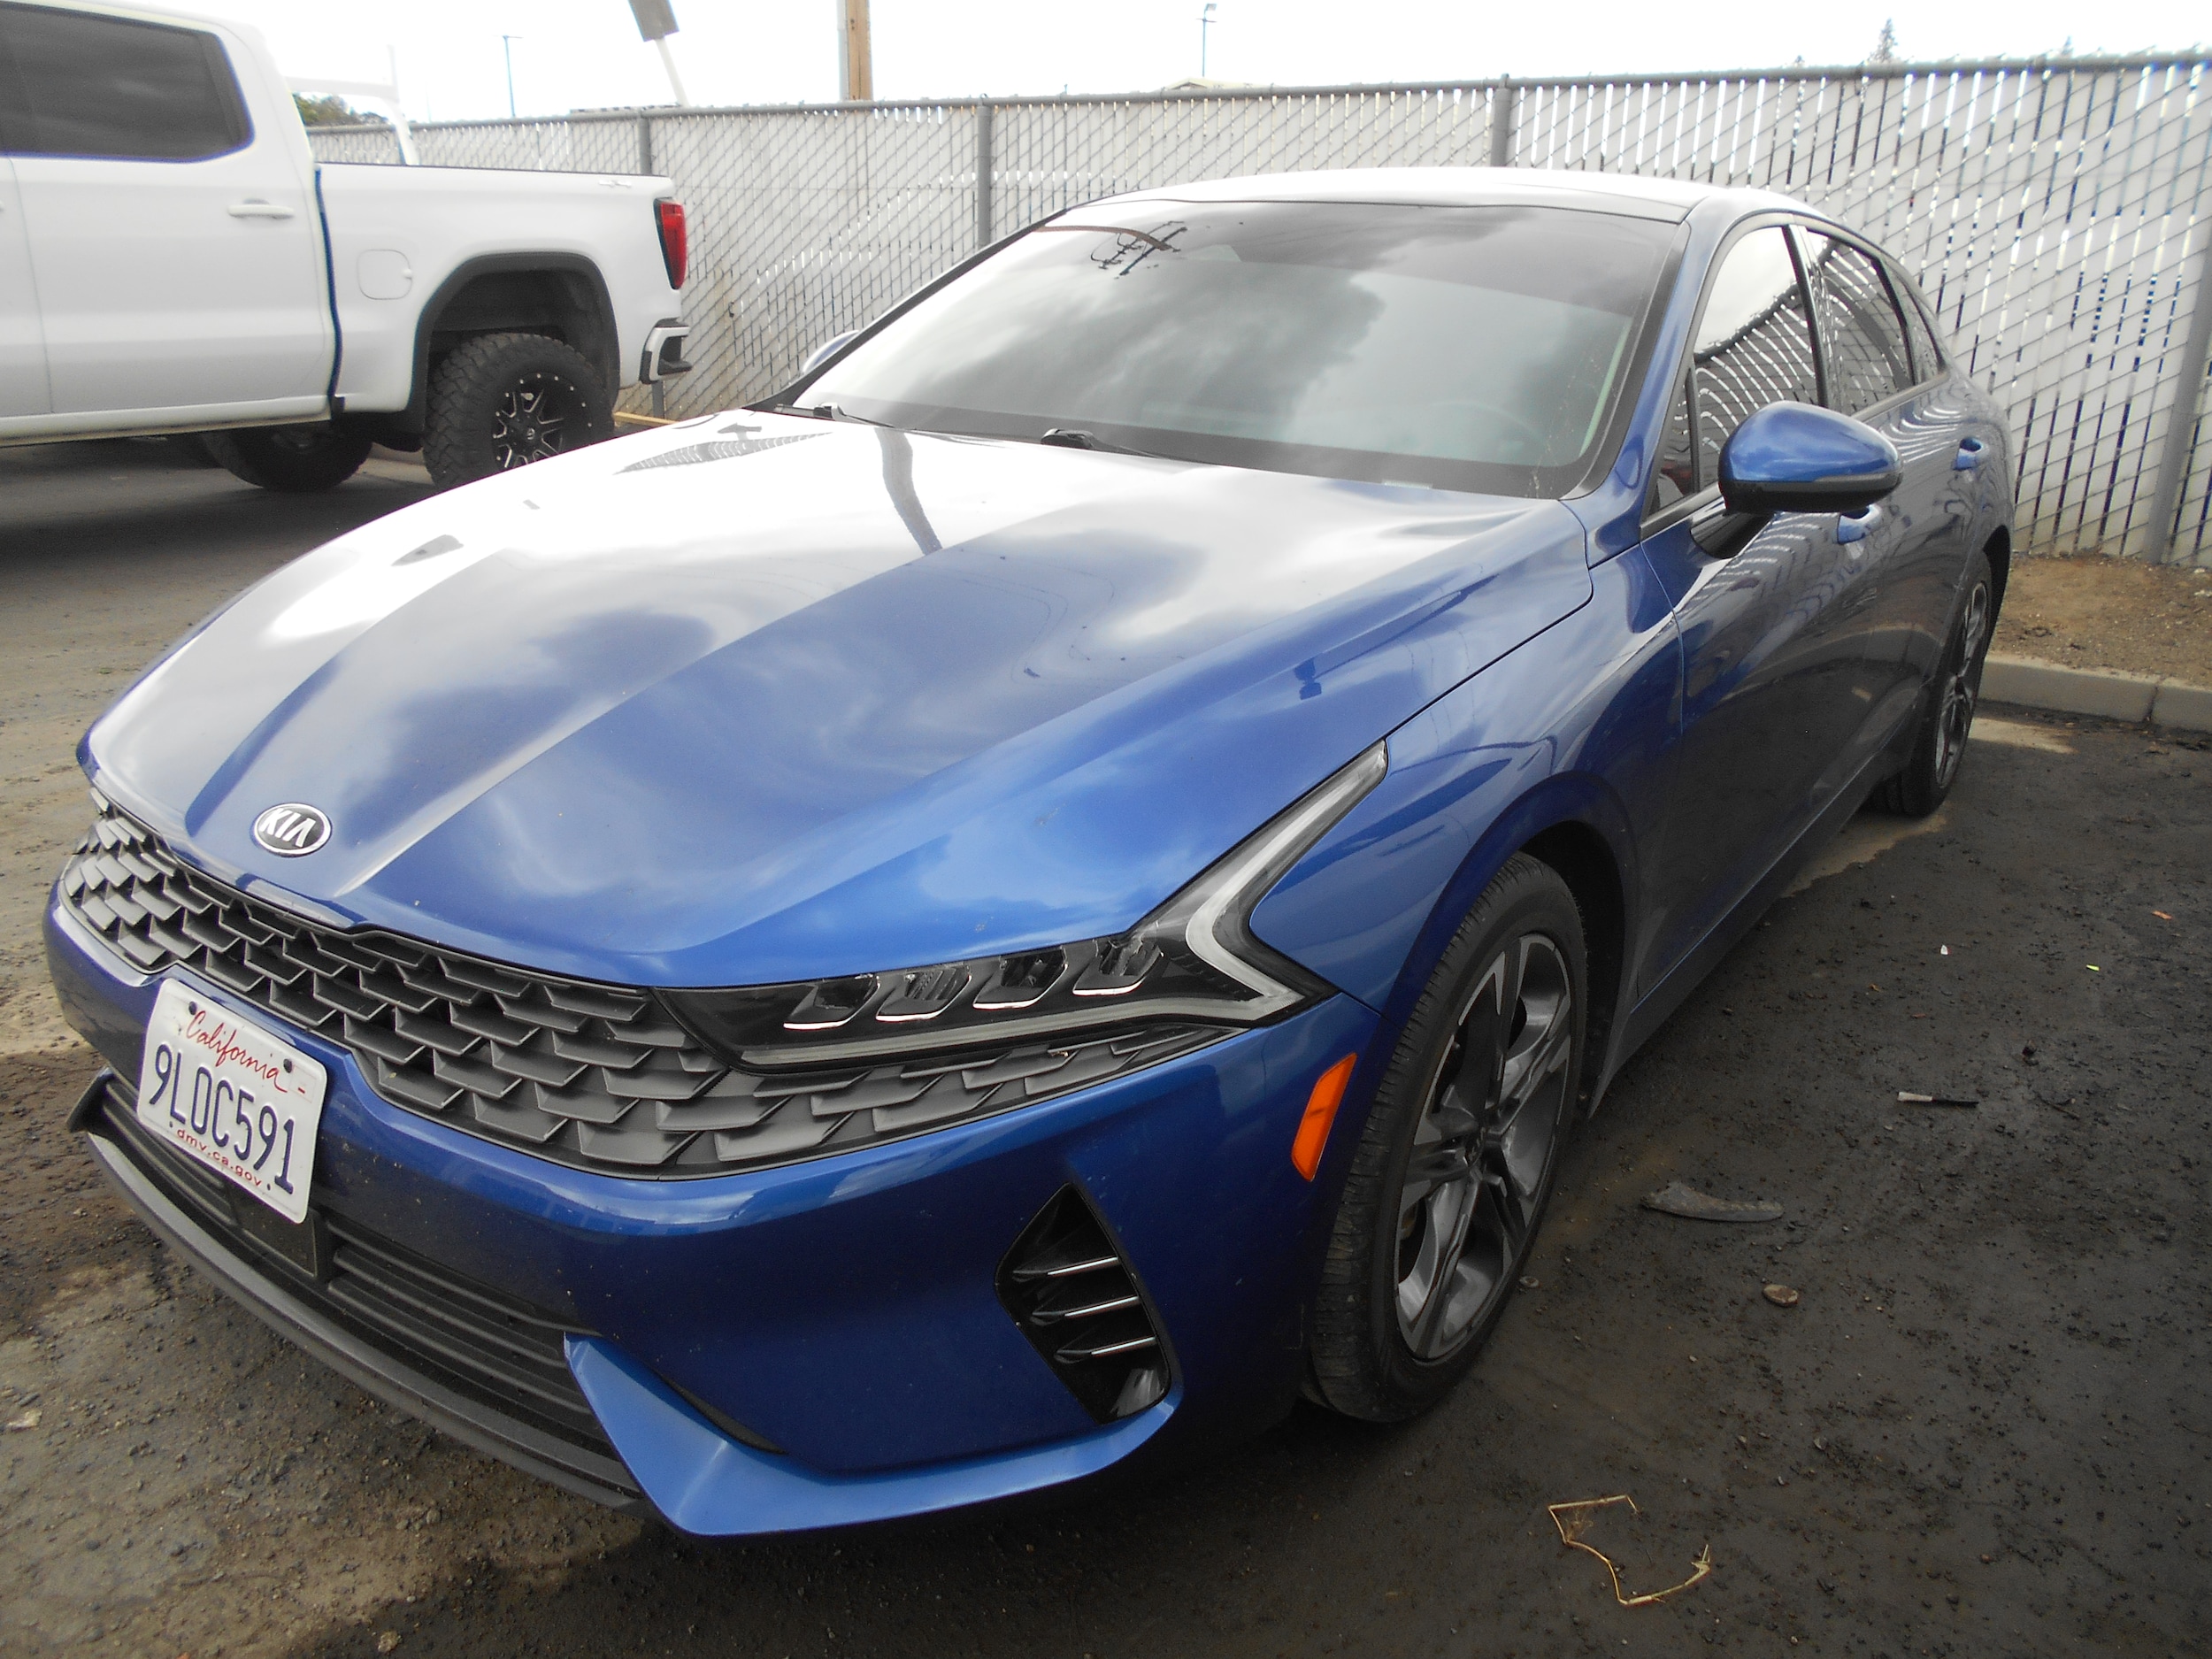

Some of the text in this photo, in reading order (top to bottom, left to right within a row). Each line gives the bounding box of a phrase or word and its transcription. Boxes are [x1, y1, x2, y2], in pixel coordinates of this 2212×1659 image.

[258, 808, 316, 848] KIA
[186, 1010, 288, 1093] California
[176, 1128, 263, 1187] dmv.ca.gov
